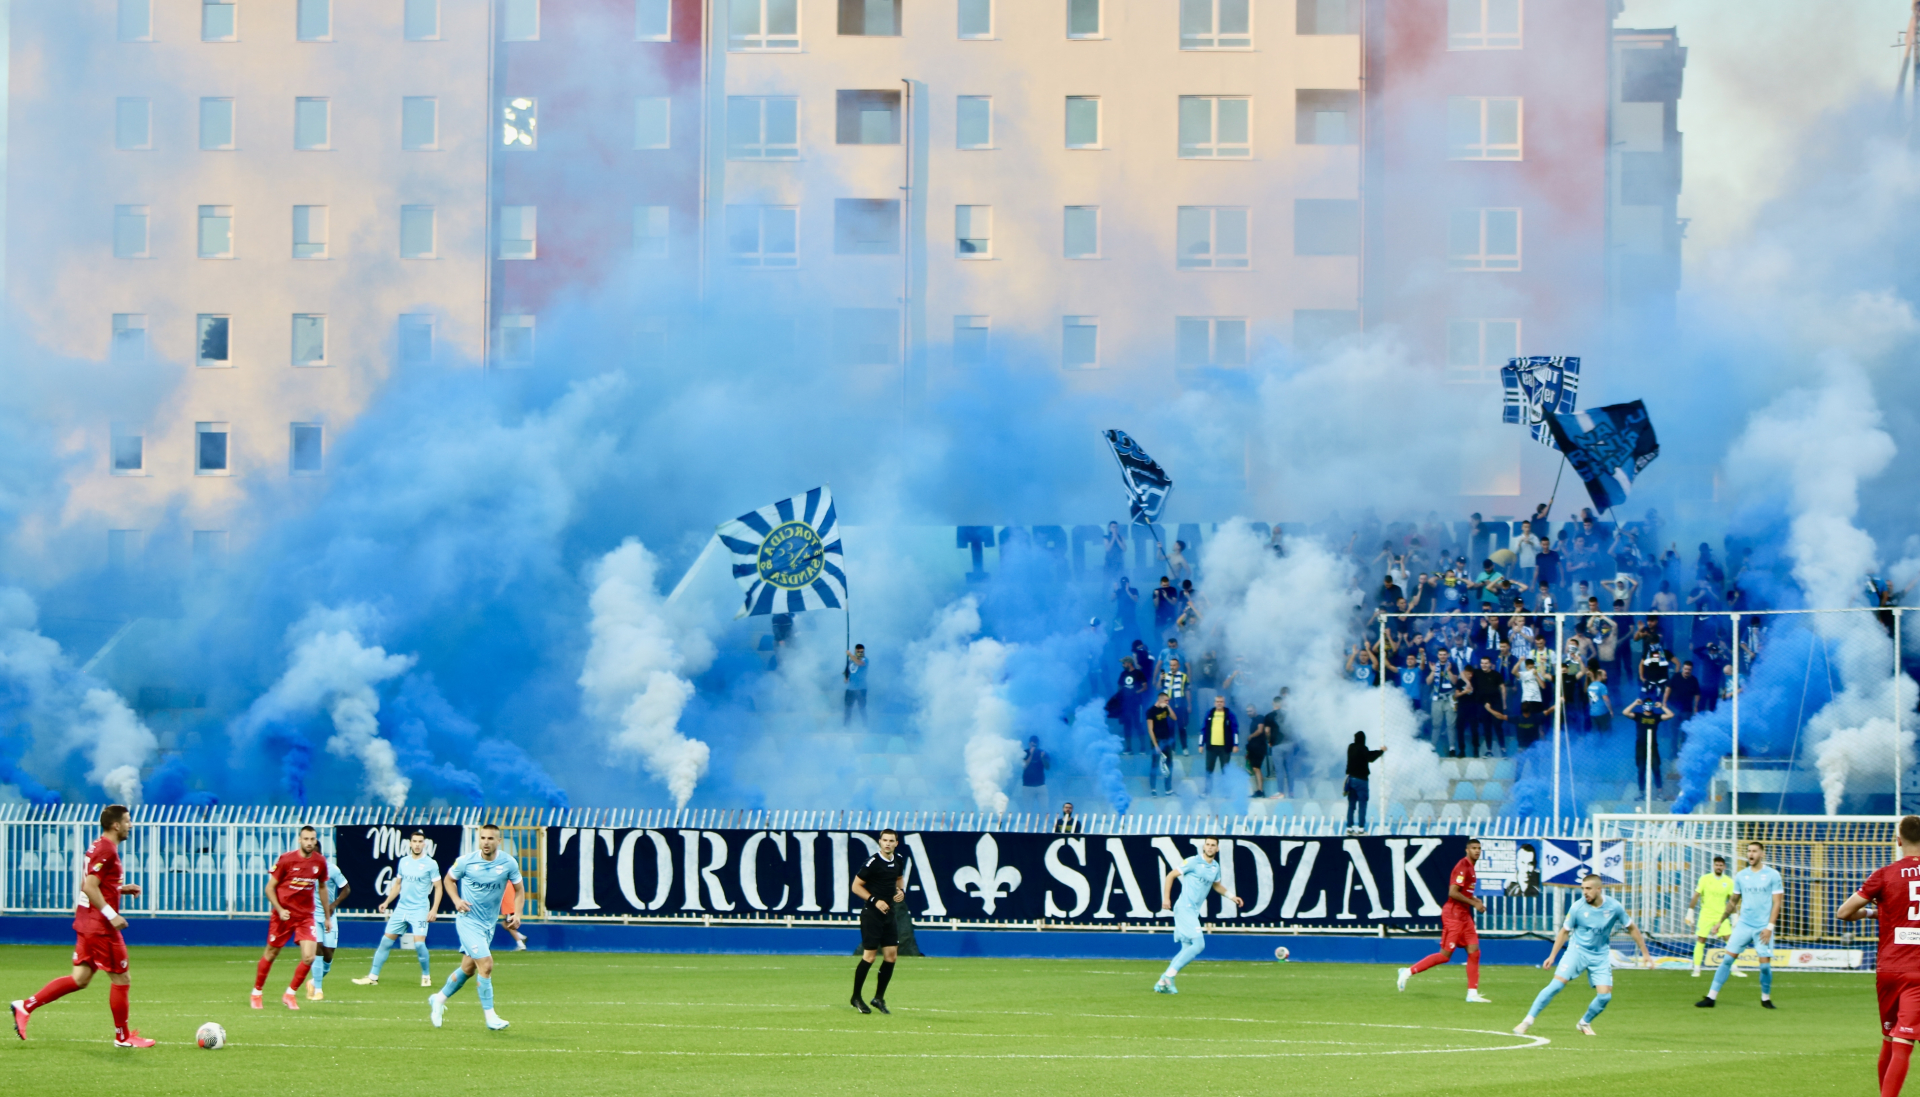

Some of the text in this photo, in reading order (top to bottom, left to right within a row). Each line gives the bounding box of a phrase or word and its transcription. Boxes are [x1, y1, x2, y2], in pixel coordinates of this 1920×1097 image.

[956, 524, 1204, 583] TORCDA
[1578, 842, 1592, 856] T
[1545, 854, 1560, 867] 19
[1044, 836, 1443, 919] SANDZAK
[417, 920, 427, 929] 30
